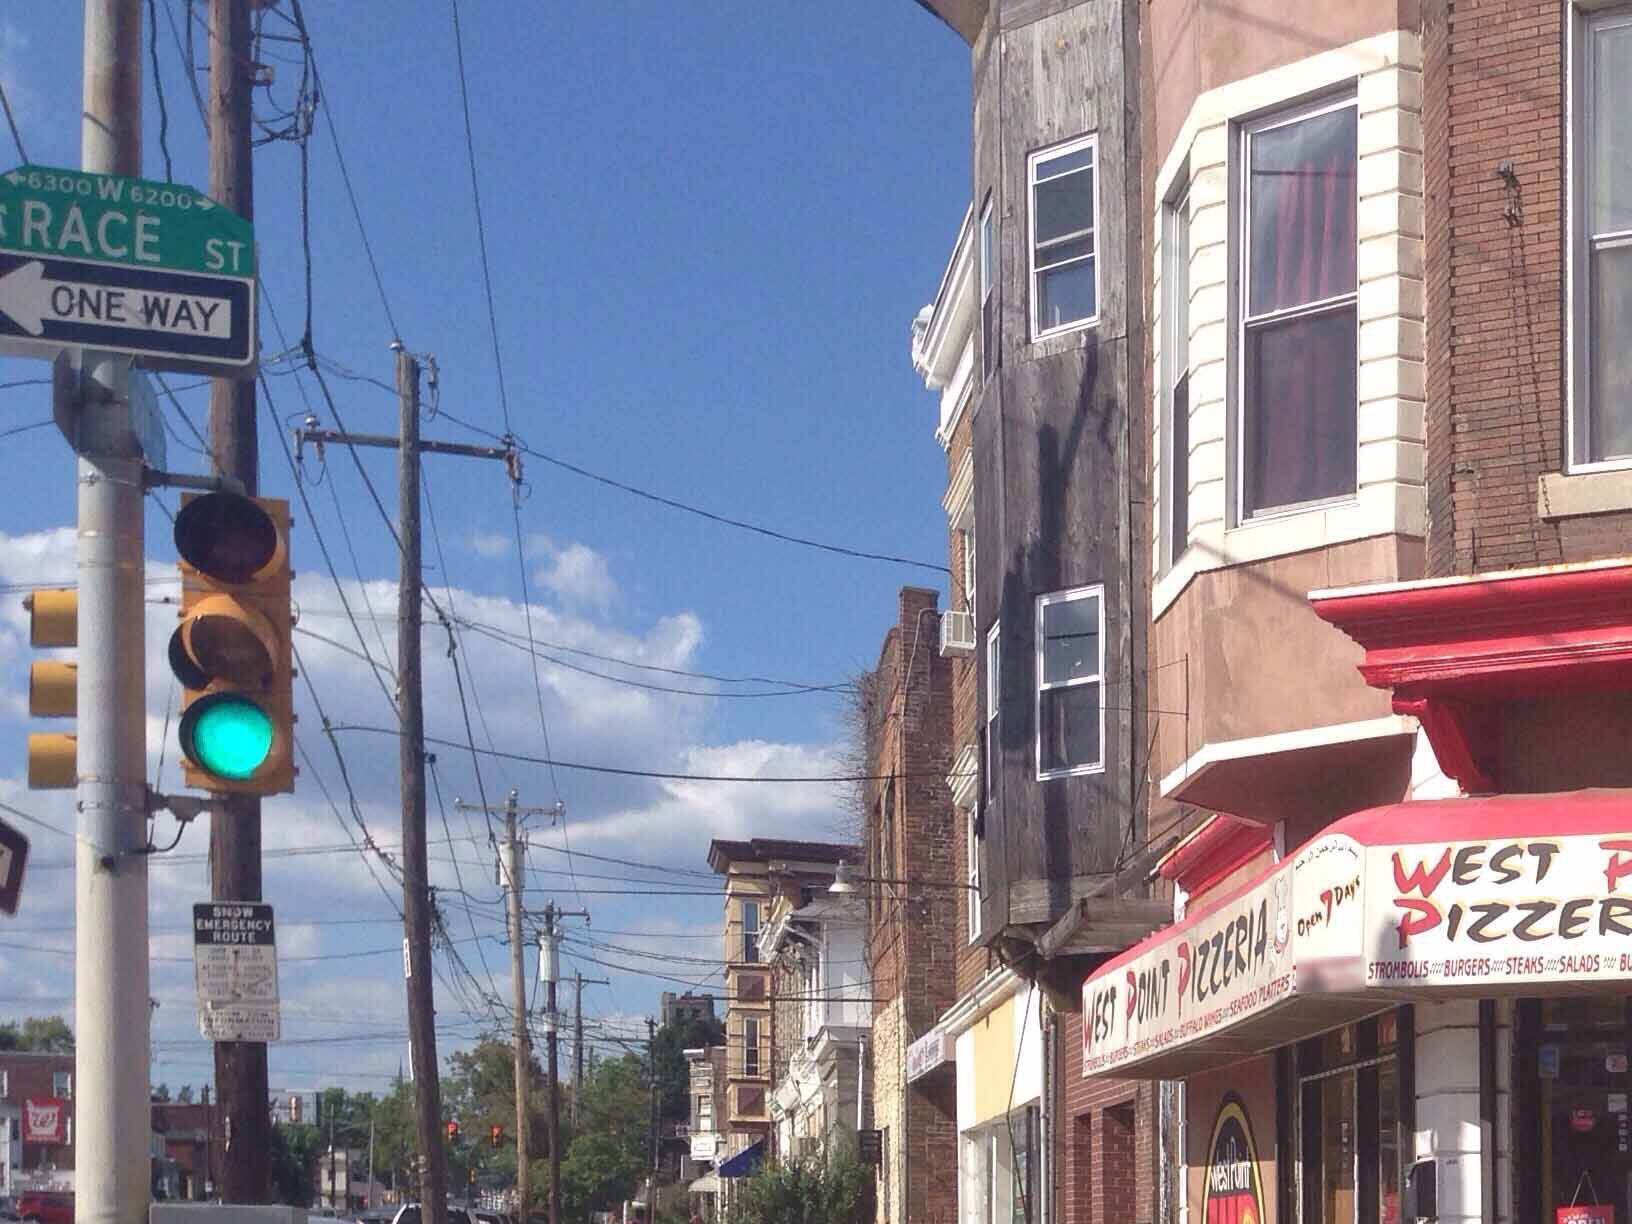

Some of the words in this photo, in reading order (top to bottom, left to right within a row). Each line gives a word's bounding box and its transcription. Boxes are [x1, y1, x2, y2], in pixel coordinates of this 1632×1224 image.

[27, 171, 92, 196] 6300
[97, 177, 124, 202] W
[130, 185, 193, 210] 6200
[23, 200, 161, 263] RACE
[205, 237, 246, 272] ST
[51, 285, 127, 323] ONE
[142, 294, 220, 332] WAY
[1391, 841, 1560, 899] WEST
[196, 919, 273, 931] EMERGENCY
[212, 906, 254, 918] SNOW
[1320, 889, 1333, 929] 7
[212, 931, 256, 943] ROUTE
[1083, 985, 1117, 1055] WEST
[1126, 959, 1170, 1040] POINT
[1177, 897, 1268, 1019] PIZZERIA
[1367, 960, 1430, 979] STROMBOLIS
[1443, 957, 1491, 977] BURGERS
[1505, 955, 1545, 975] STEAKS
[1558, 954, 1600, 974] SALADS
